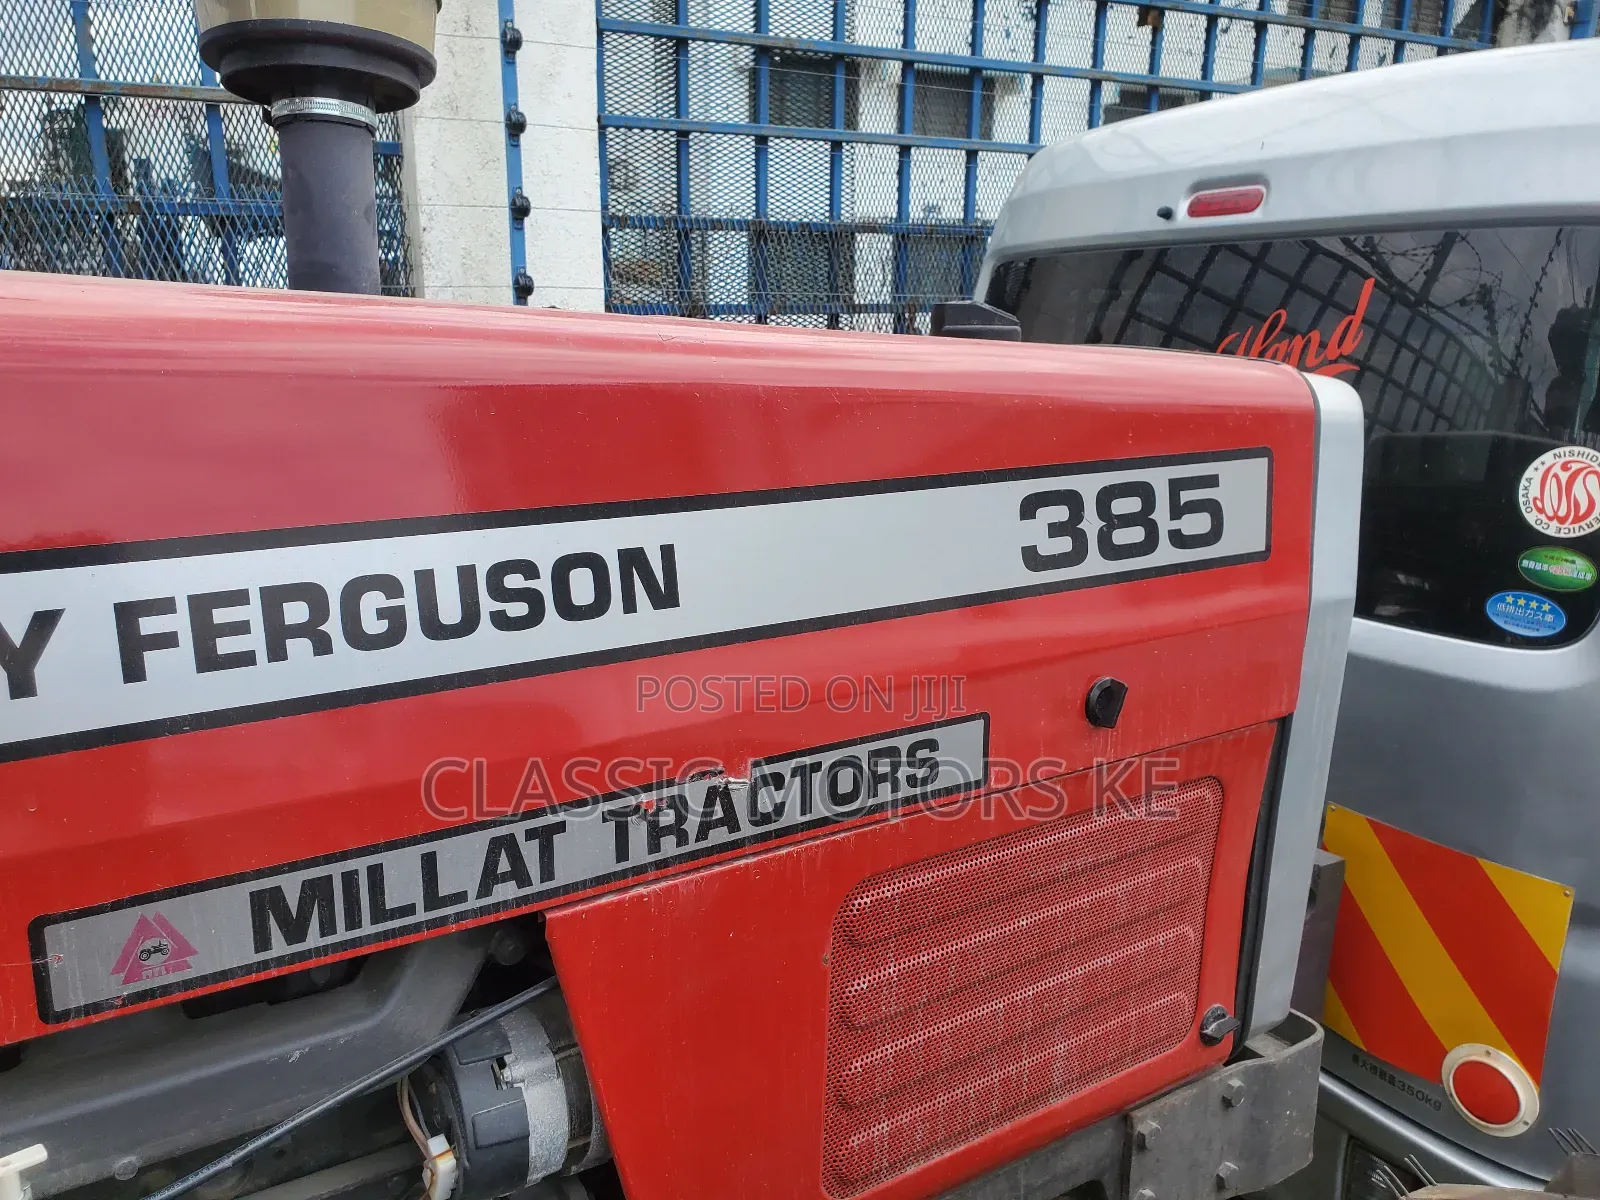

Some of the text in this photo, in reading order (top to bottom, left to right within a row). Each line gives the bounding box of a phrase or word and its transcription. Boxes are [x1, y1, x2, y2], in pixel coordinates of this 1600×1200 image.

[1553, 449, 1600, 466] NISHID
[1019, 474, 1224, 572] 385
[1522, 477, 1534, 514] OSAKA
[1554, 512, 1600, 535] ERVICE
[113, 544, 680, 684] FERGUSON
[249, 737, 939, 955] MILLAT TRACTORS
